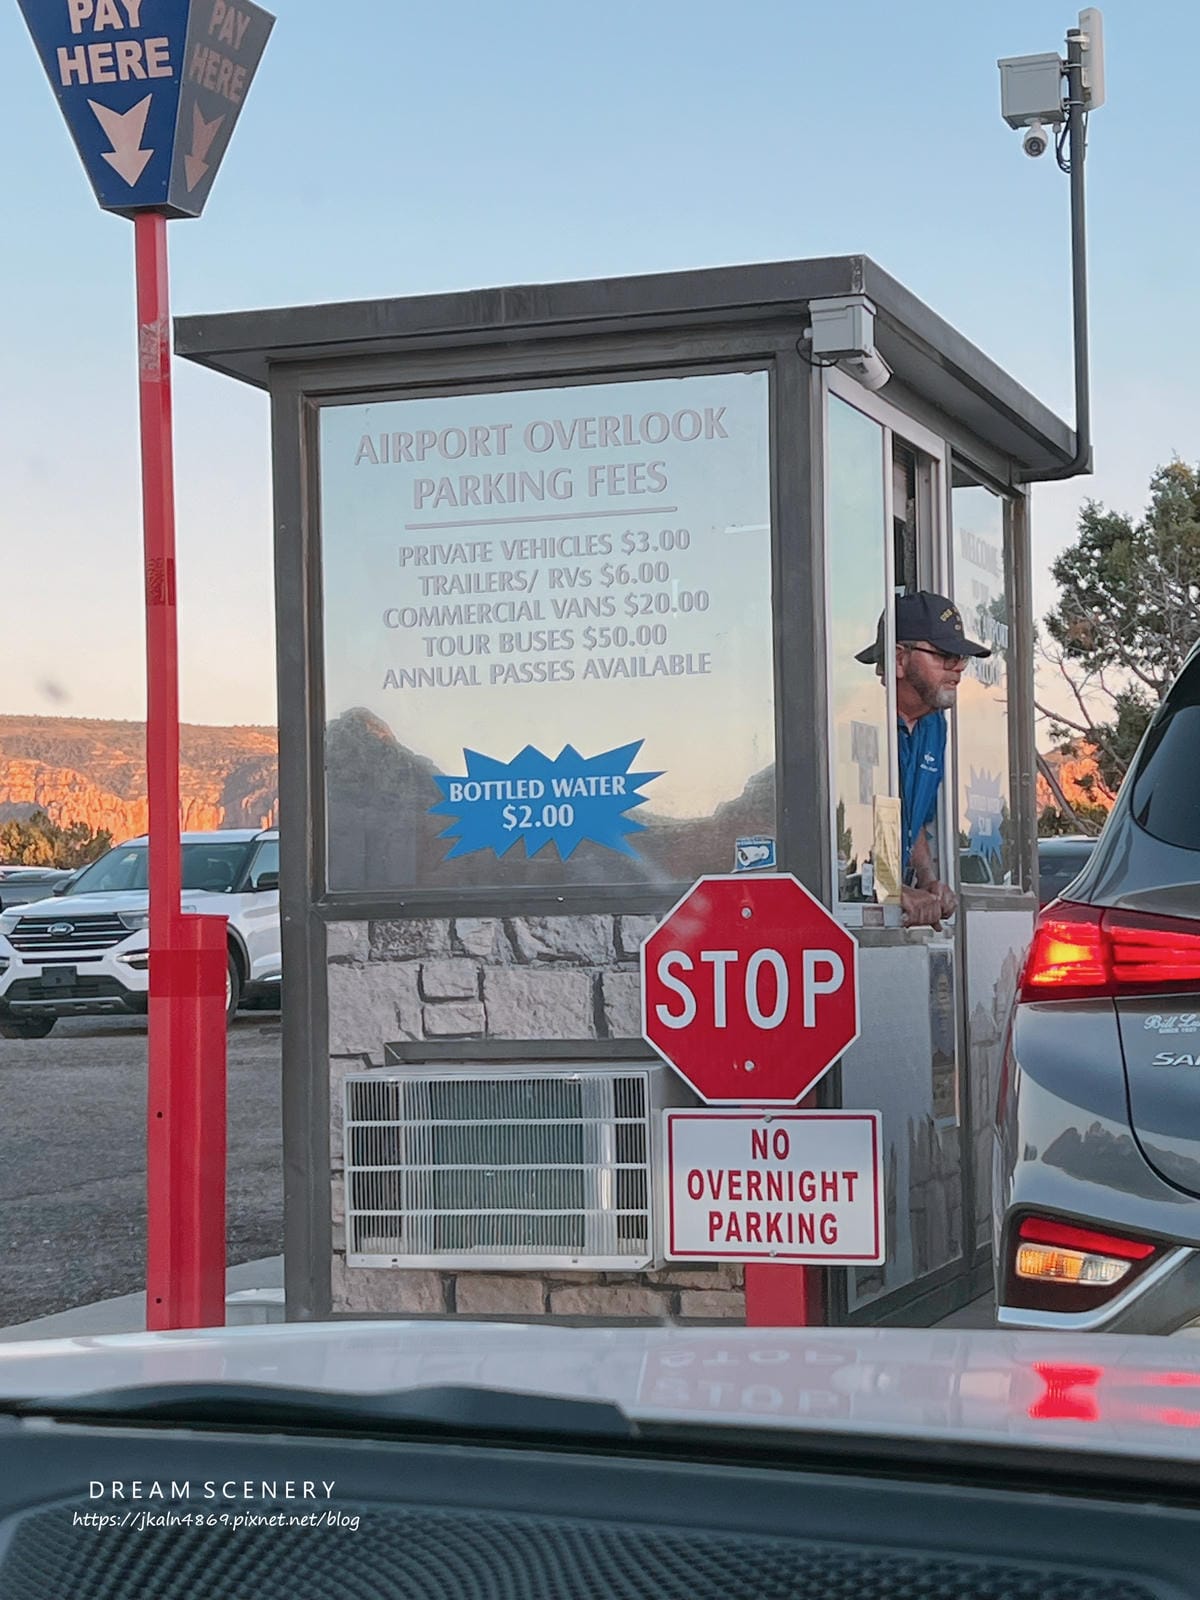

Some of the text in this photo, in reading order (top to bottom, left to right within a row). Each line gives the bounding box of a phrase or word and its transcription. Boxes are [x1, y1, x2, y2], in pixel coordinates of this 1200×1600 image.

[68, 0, 142, 34] PAY
[208, 1, 249, 49] PAY
[57, 37, 173, 86] HERE
[189, 43, 247, 103] HERE
[354, 407, 729, 465] AIRPORT OVERLOOK
[413, 461, 668, 510] PARKING FEES
[399, 529, 690, 567] PRIVATE VEHICLES $3.00
[418, 561, 669, 596] TRAILERS/ RVs $6.00
[383, 590, 710, 629] COMMERCIAL VANS $20.00
[422, 624, 667, 657] TOUR BUSES $50.00
[382, 653, 711, 689] ANNUAL PASSES AVAILABLE
[450, 776, 626, 802] BOTTLED WATER
[502, 804, 574, 831] $2.00
[655, 948, 845, 1030] STOP
[751, 1128, 790, 1160] NO
[687, 1169, 858, 1202] OVERNIGHT
[708, 1211, 838, 1245] PARKING
